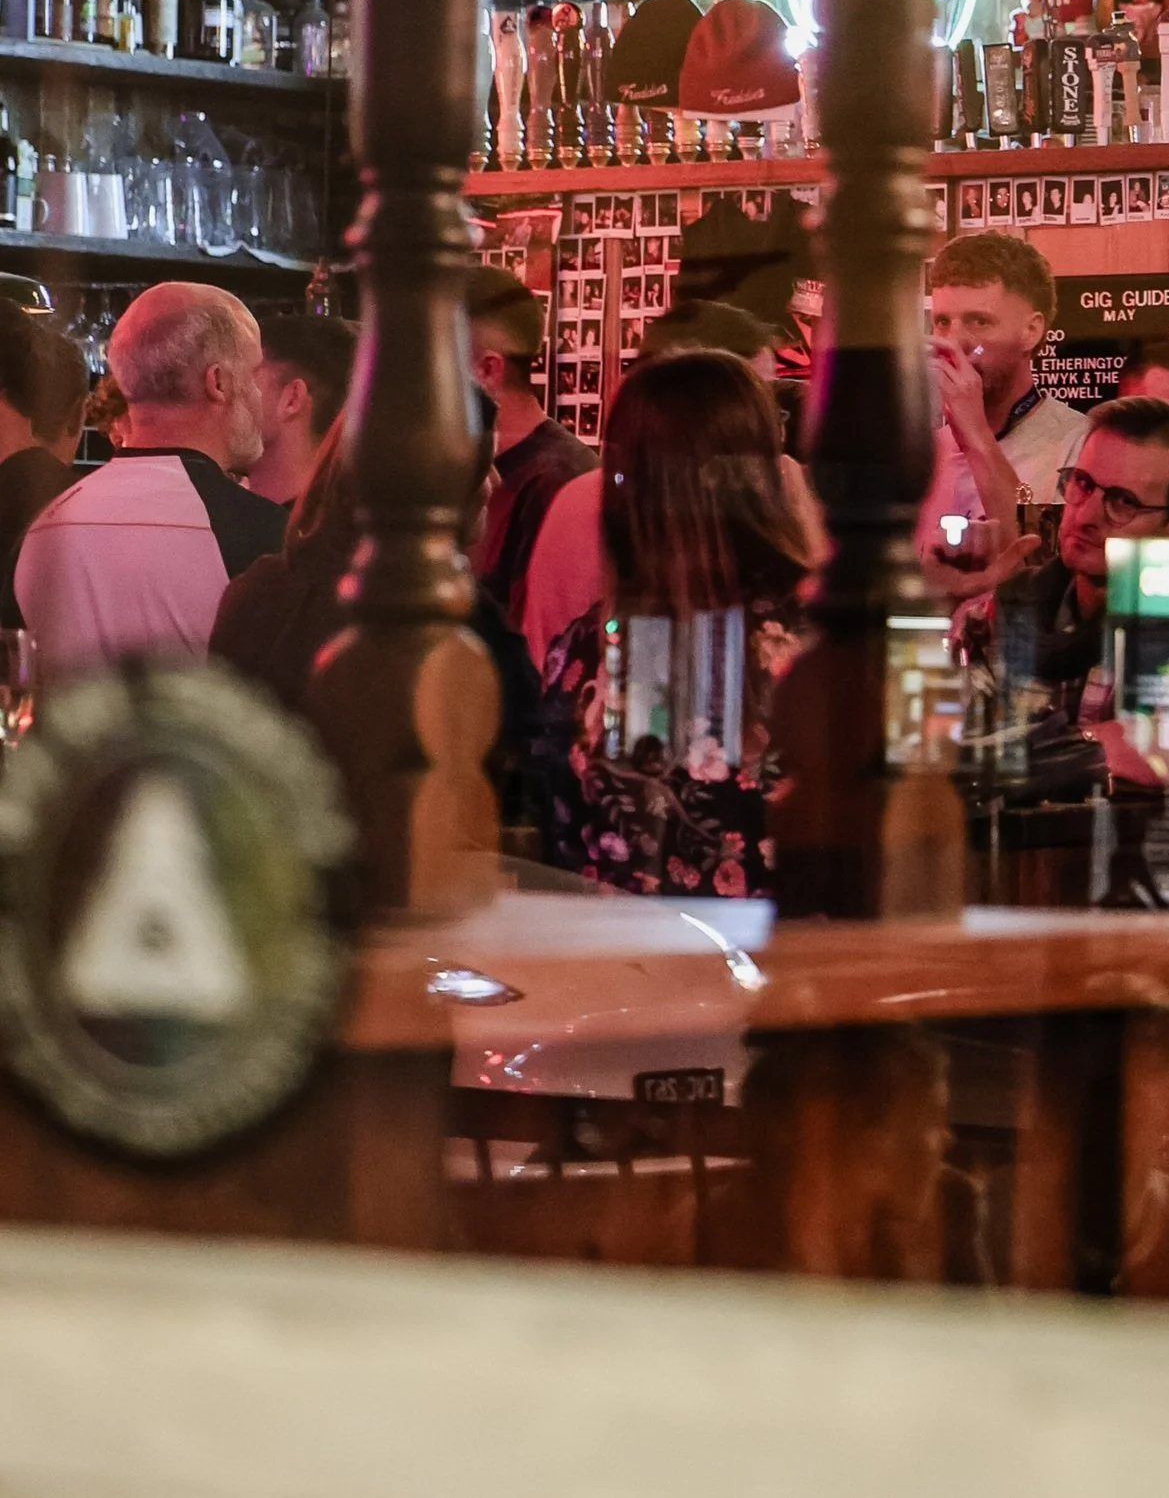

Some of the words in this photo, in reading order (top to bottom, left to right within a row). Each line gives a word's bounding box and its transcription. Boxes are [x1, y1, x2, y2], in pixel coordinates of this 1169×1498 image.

[1060, 47, 1080, 113] STONE
[1080, 292, 1112, 308] GIG
[1104, 309, 1136, 321] MAY
[1042, 356, 1127, 371] ETHERINGTO
[1083, 372, 1090, 384] &
[1094, 371, 1119, 383] THE
